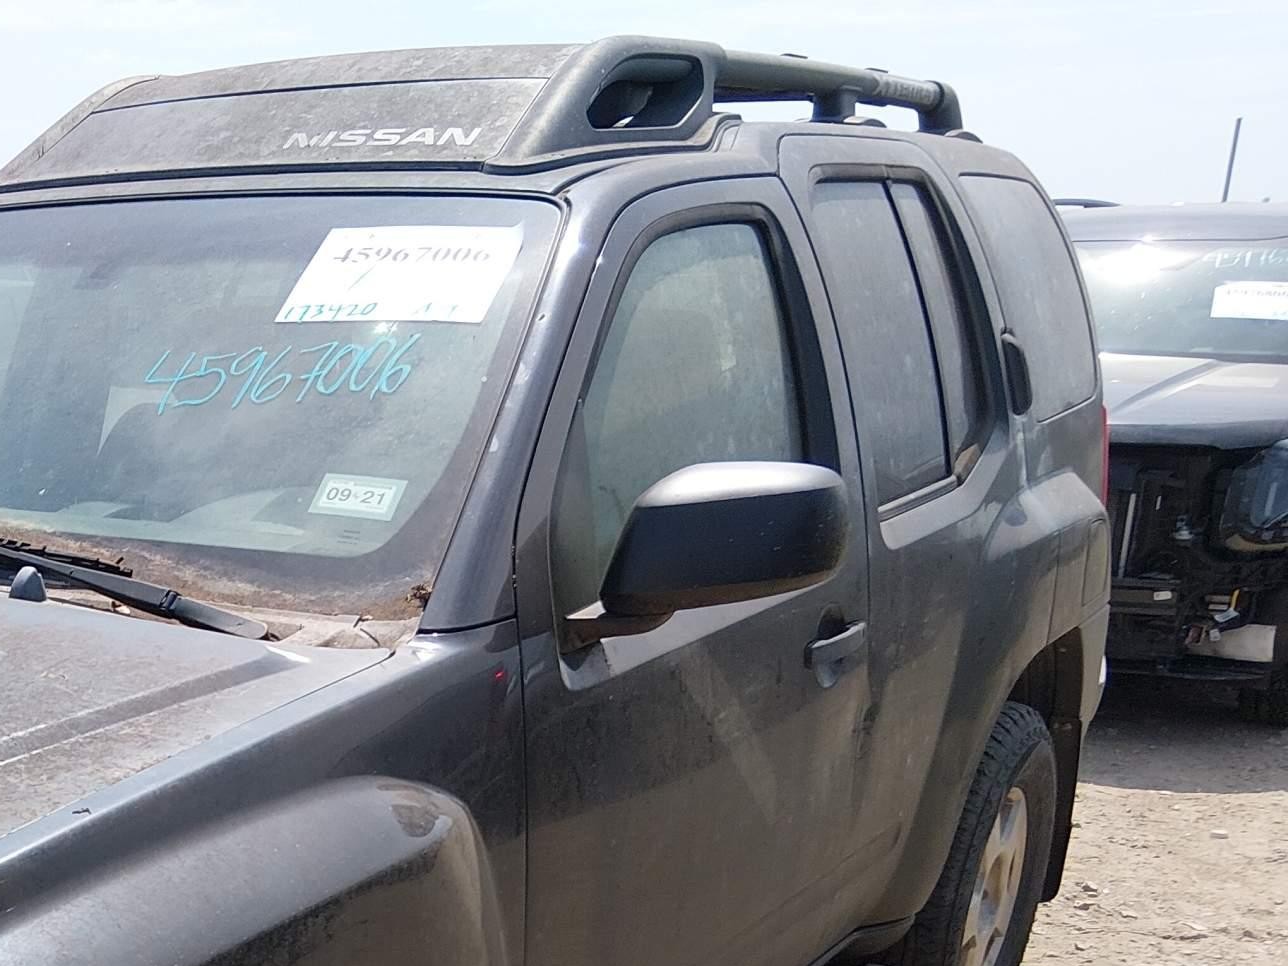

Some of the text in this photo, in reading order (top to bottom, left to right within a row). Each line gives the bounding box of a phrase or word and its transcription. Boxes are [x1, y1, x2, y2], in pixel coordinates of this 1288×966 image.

[283, 127, 482, 149] NISSAN
[333, 247, 491, 264] 45967006
[144, 332, 421, 416] 45967006
